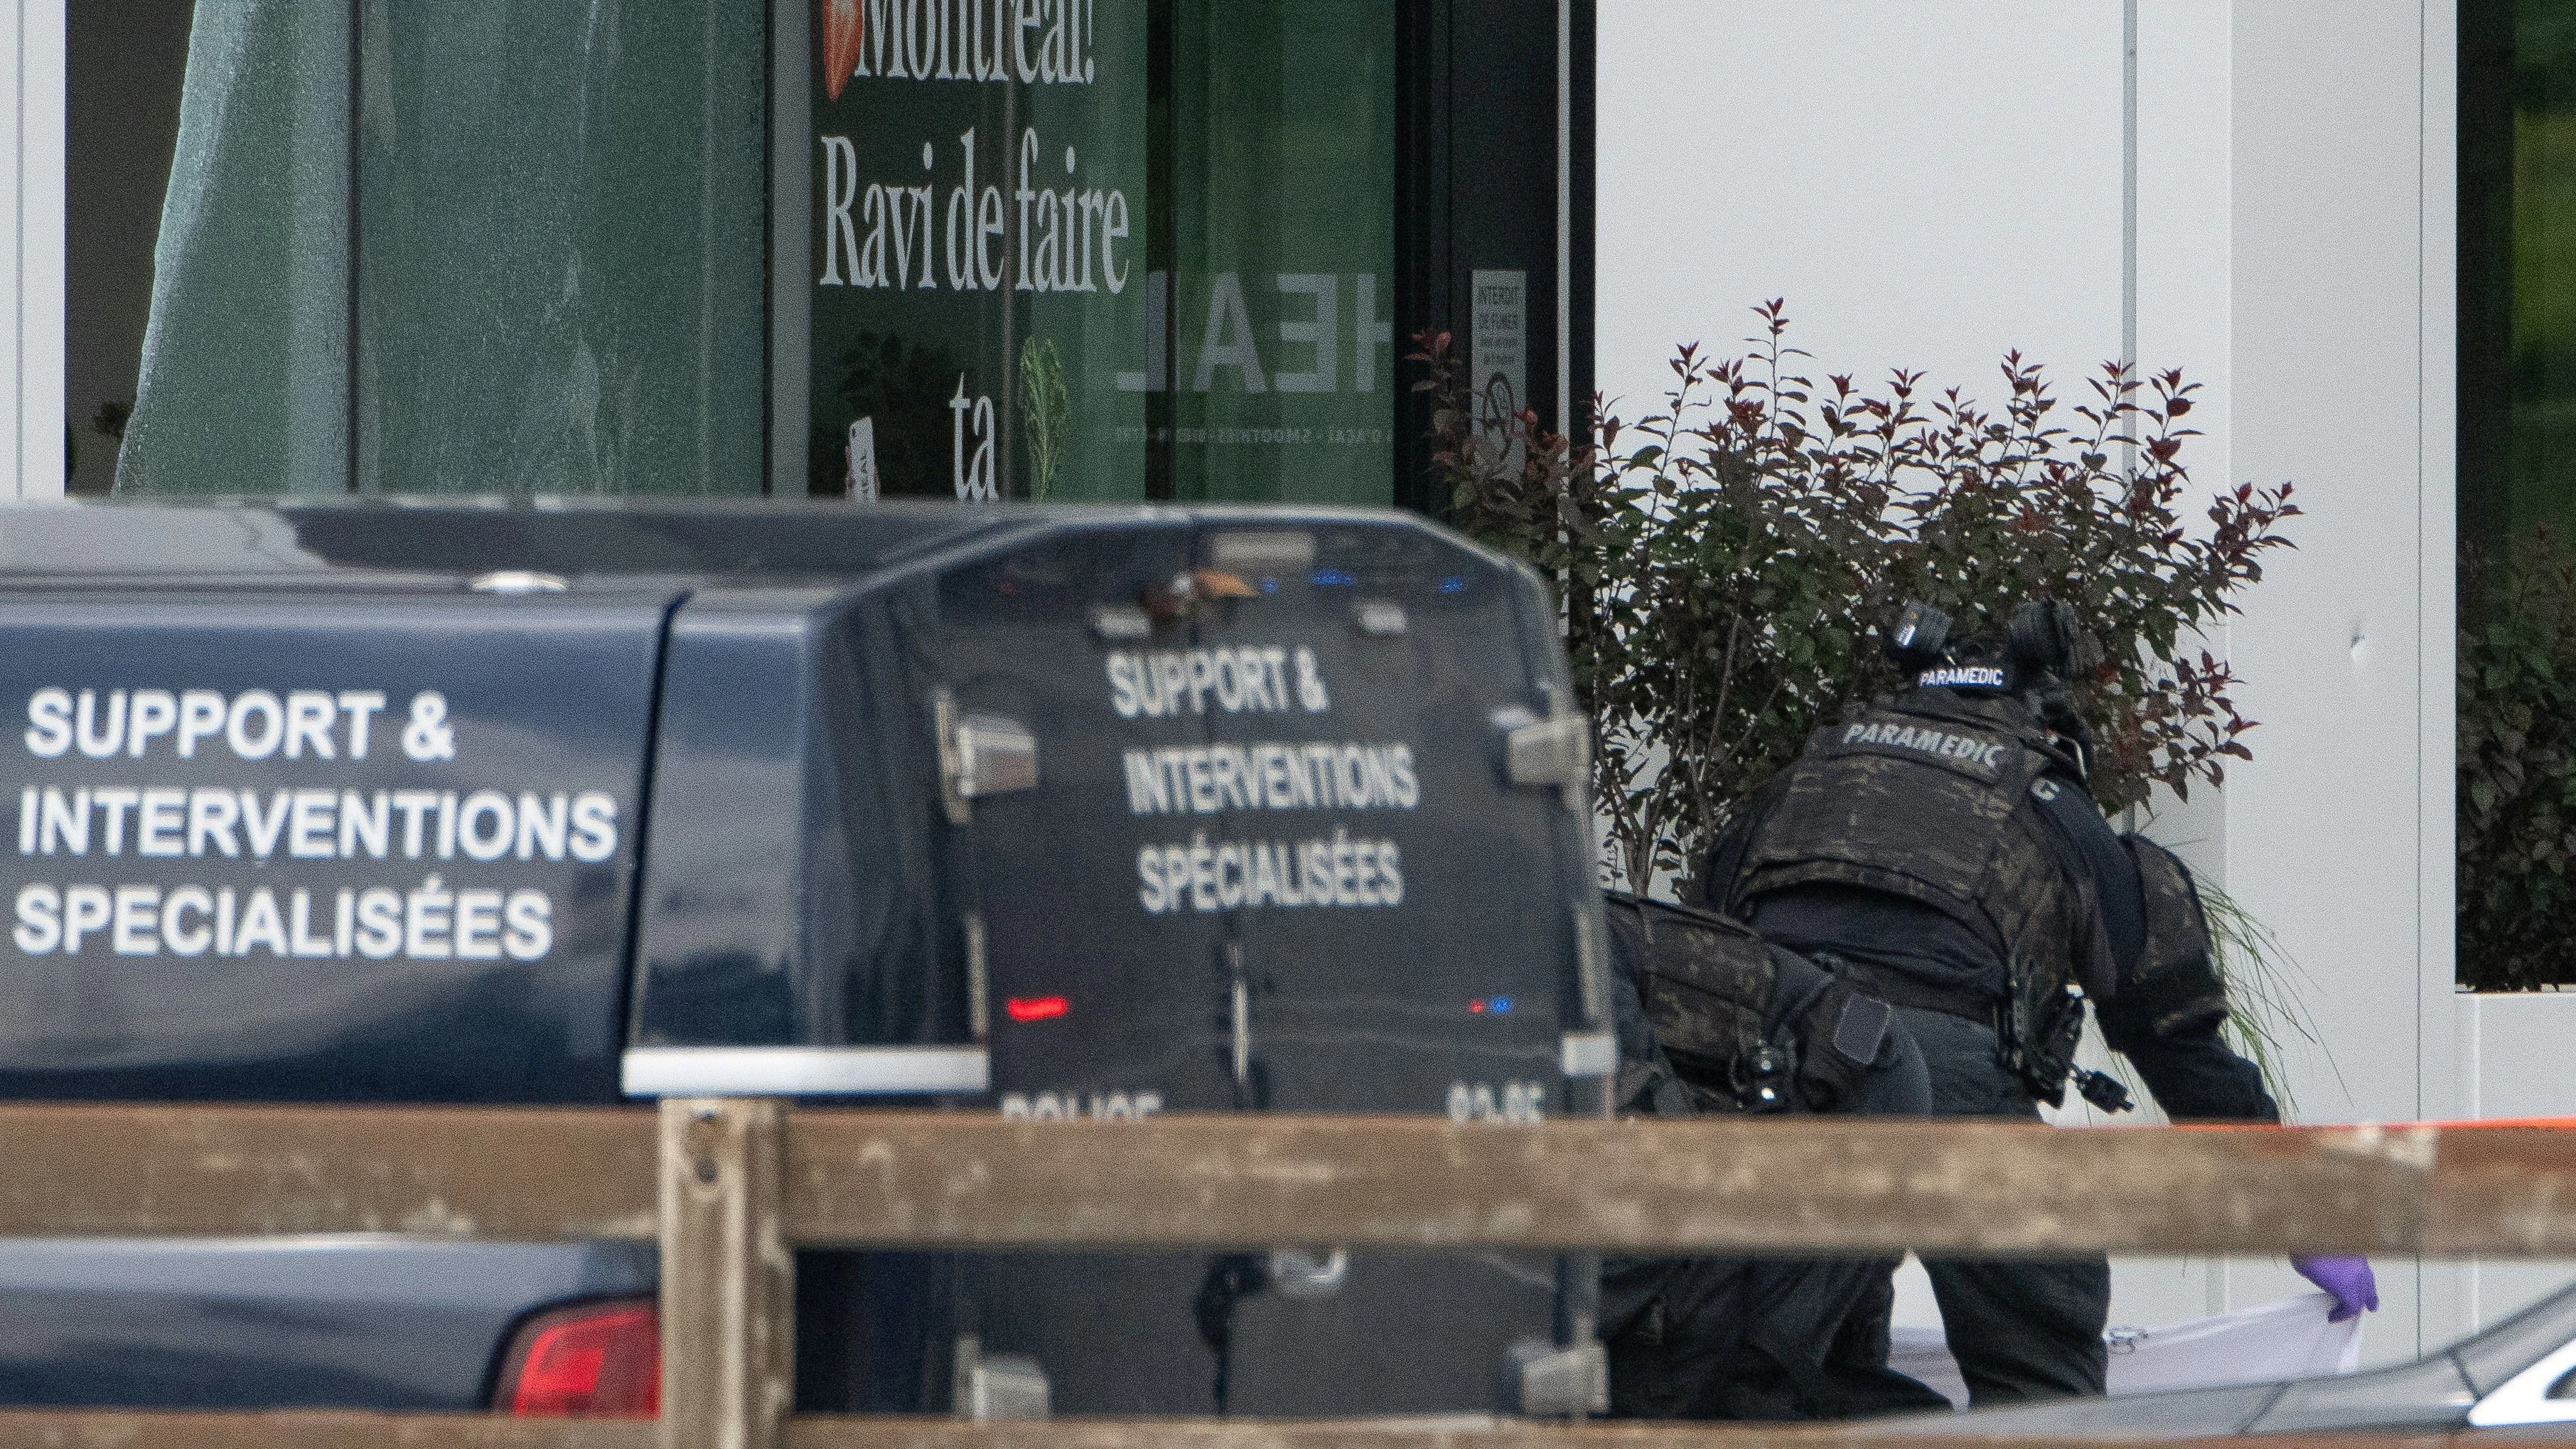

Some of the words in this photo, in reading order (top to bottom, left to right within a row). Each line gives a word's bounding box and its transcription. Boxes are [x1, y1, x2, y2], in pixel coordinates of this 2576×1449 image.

[820, 135, 938, 291] Ravi
[946, 127, 1005, 291] de
[1015, 127, 1130, 295] faire
[949, 372, 999, 501] ta
[1107, 646, 1287, 718] SUPPORT
[1295, 646, 1329, 712] &
[1919, 667, 2005, 688] PARAMEDIC
[24, 687, 387, 761] SUPPORT
[401, 690, 456, 761] &
[1843, 723, 2007, 769] PARAMEDIC
[1123, 742, 1421, 815] INTERVENTIONS
[18, 786, 619, 863] INTERVENTIONS
[1139, 827, 1405, 915] SPÉCIALISÉES
[13, 872, 555, 961] SPECIALISÉES
